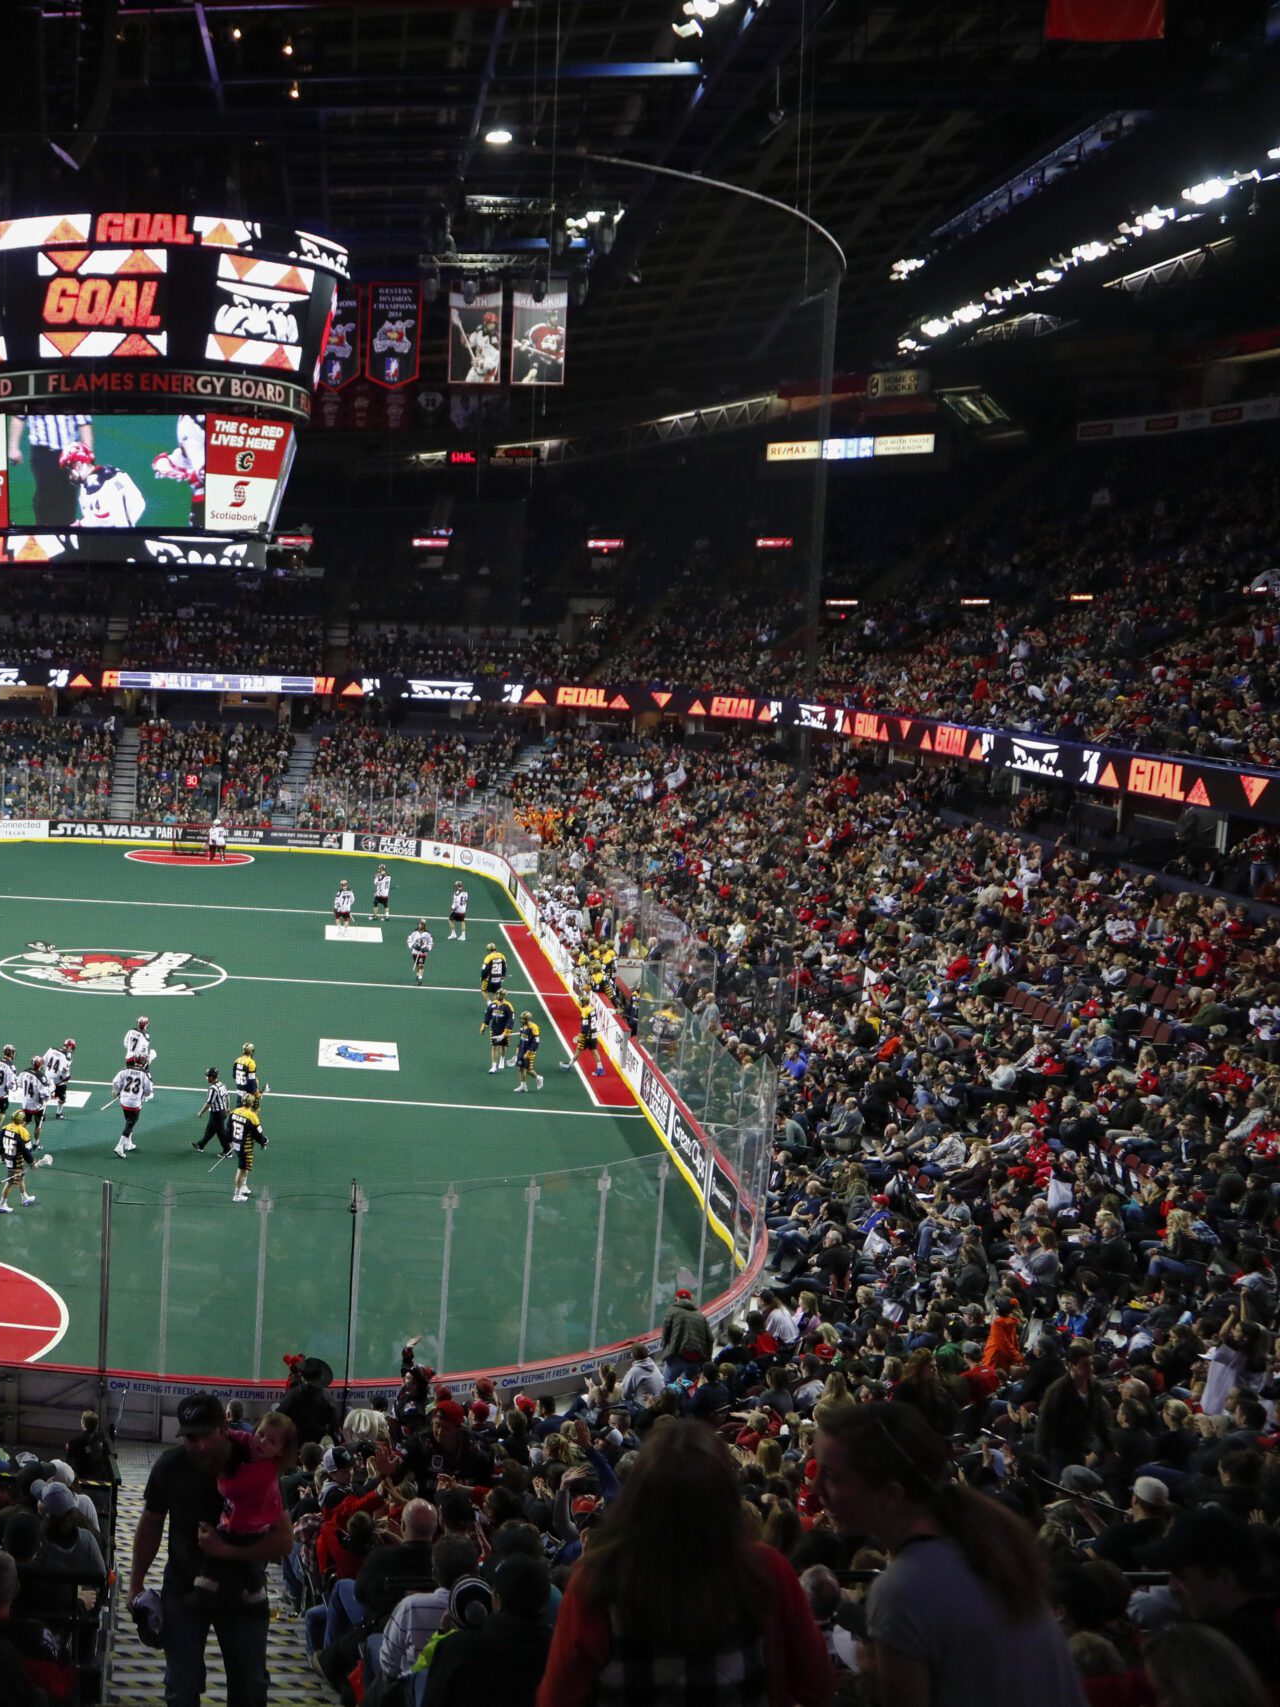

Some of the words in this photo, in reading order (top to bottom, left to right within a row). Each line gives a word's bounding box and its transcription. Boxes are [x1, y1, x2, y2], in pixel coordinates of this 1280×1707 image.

[95, 212, 195, 244] GOAL
[43, 277, 161, 328] GOAL
[373, 303, 418, 311] CHAMPIONS
[379, 295, 412, 303] DIVISION
[47, 373, 135, 393] FLAMES
[140, 374, 226, 394] ENERGY
[230, 378, 286, 402] BOARD
[214, 420, 237, 434] THE
[239, 422, 248, 435] C
[261, 425, 284, 438] RED
[210, 433, 245, 447] LIVES
[245, 436, 276, 451] HERE
[770, 445, 807, 456] RE/MAX
[210, 510, 258, 522] Scotiabank
[556, 687, 608, 708] GOAL
[710, 696, 756, 719] GOAL
[854, 713, 879, 739] GOAL
[935, 725, 968, 756] GOAL
[1128, 757, 1186, 801] GOAL
[50, 822, 102, 837] STAR
[102, 824, 156, 838] WARS
[156, 826, 184, 840] PARTY
[378, 845, 417, 857] LACROSSE
[380, 837, 417, 847] ELEV8
[46, 1057, 60, 1074] 44
[24, 1082, 34, 1098] 14
[124, 1075, 142, 1094] 23
[673, 1114, 692, 1157] Great
[520, 1372, 545, 1384] KEEPING
[552, 1368, 570, 1379] FRESH
[133, 1383, 163, 1394] KEEPING
[164, 1386, 171, 1394] IT
[173, 1387, 195, 1396] FRESH
[235, 1390, 265, 1400] KEEPING
[336, 1390, 365, 1400] KEEPING
[375, 1388, 397, 1399] FRESH
